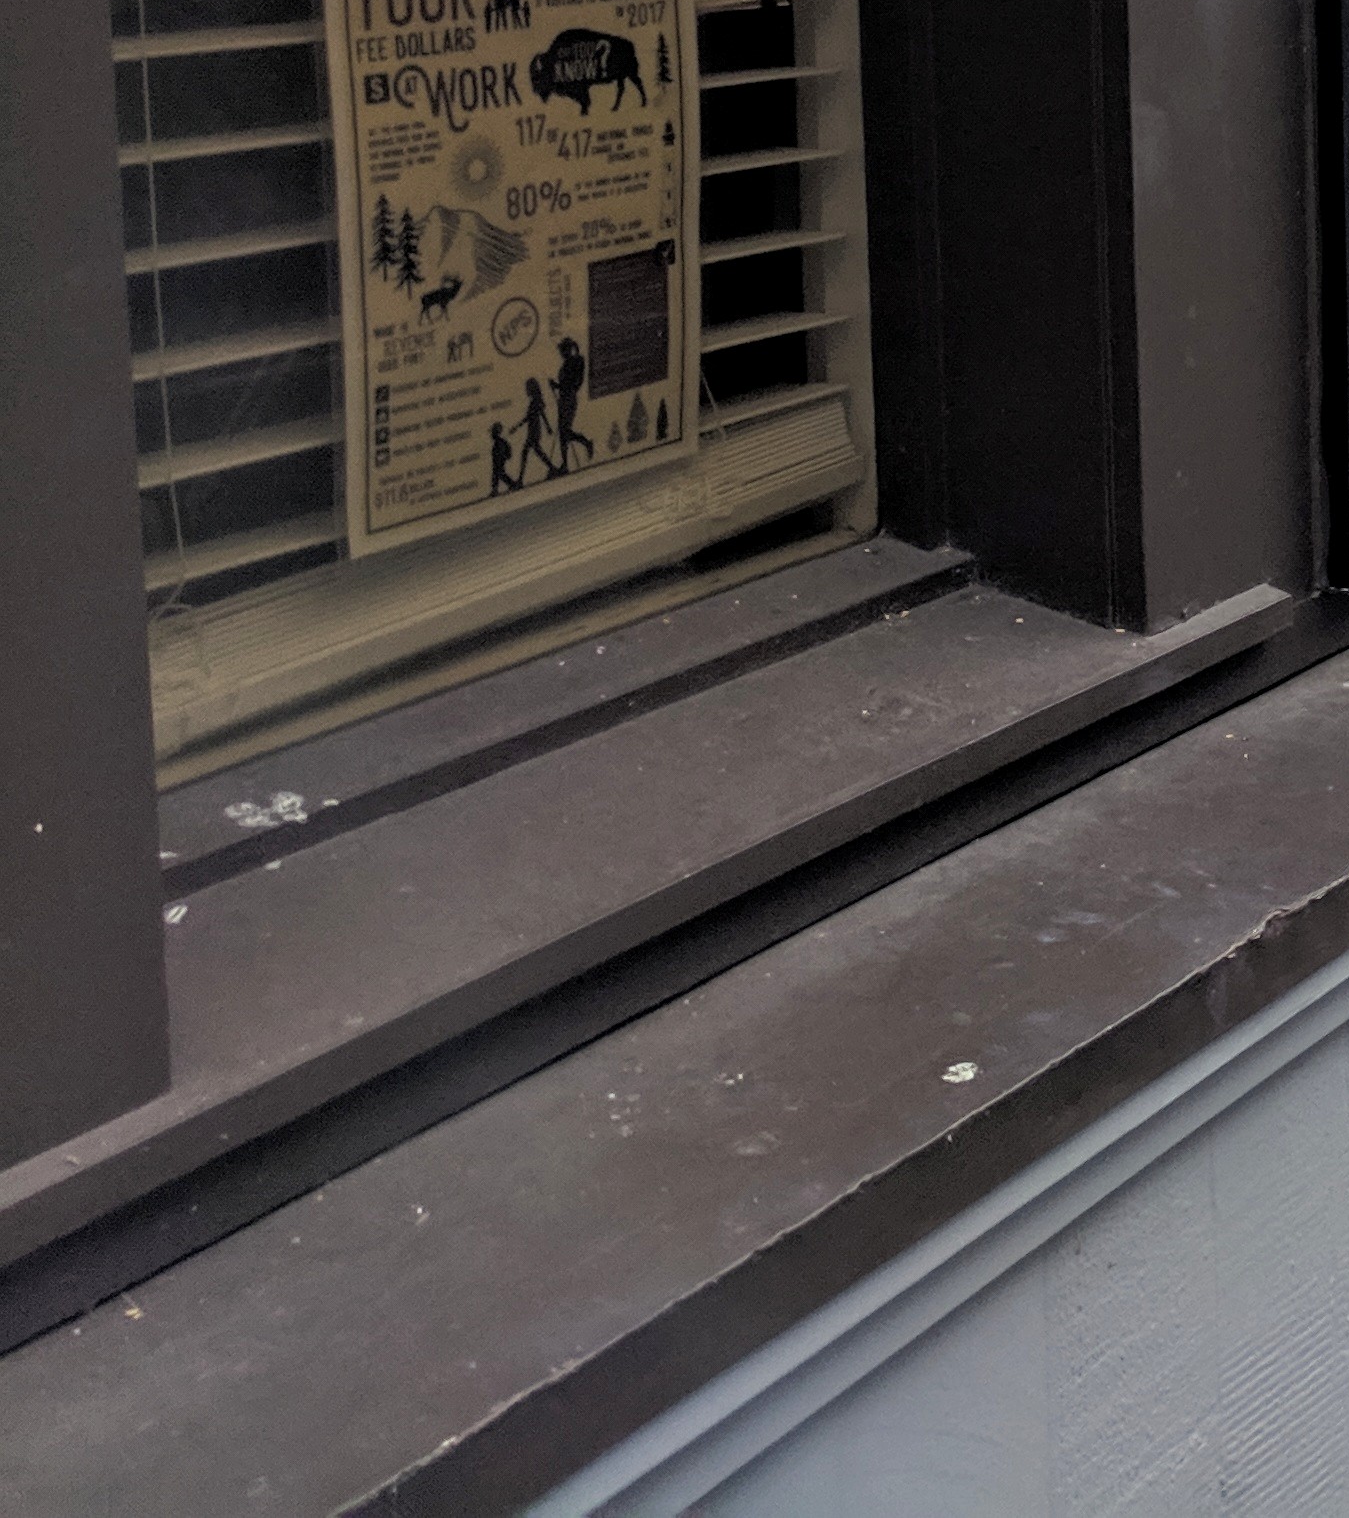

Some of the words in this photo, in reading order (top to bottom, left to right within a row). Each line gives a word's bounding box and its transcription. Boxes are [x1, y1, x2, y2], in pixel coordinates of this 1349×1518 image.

[627, 0, 666, 29] 2017
[356, 36, 388, 63] FEE
[395, 27, 476, 60] DOLLARS
[405, 62, 523, 133] WORK
[515, 114, 546, 147] 117
[557, 128, 593, 161] 417
[506, 177, 572, 220] 80%
[497, 308, 533, 347] NPS
